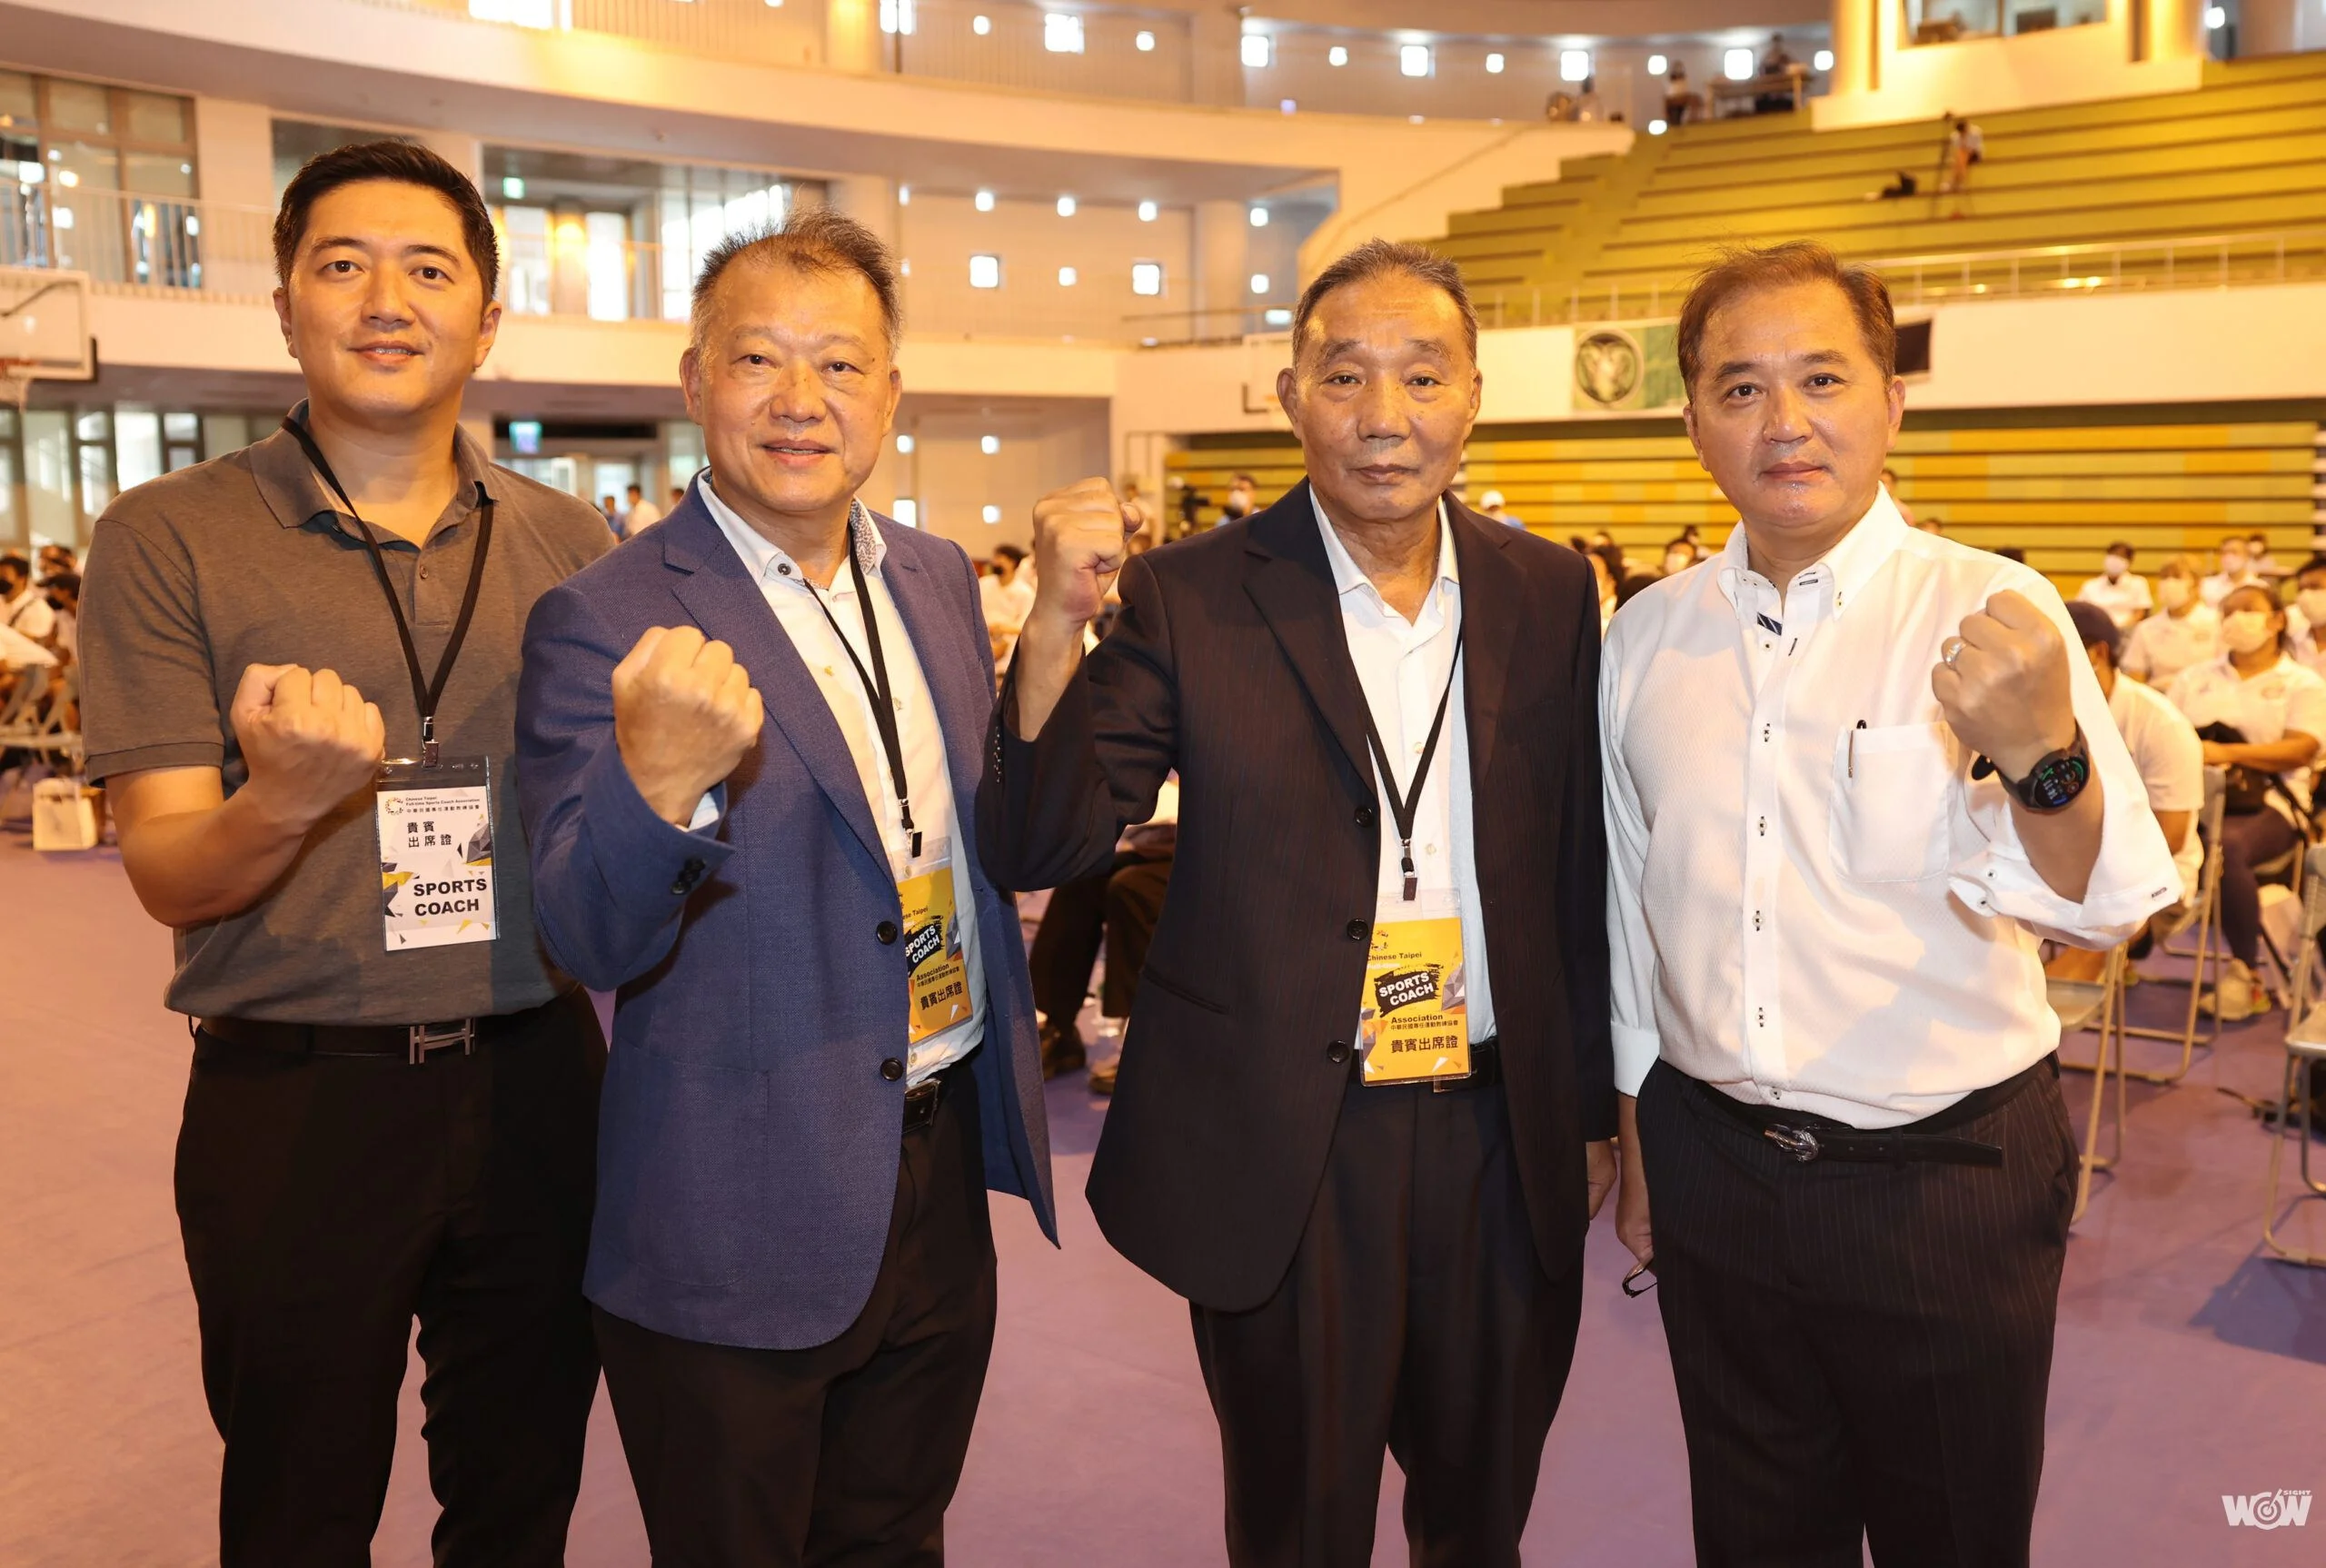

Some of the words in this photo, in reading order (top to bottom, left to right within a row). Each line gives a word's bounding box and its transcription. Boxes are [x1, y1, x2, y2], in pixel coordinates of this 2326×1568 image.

[407, 820, 434, 833] 貴賓
[408, 834, 452, 848] 出席證
[413, 878, 487, 896] SPORTS
[414, 898, 480, 916] COACH
[912, 905, 929, 916] Taipei
[912, 935, 940, 963] COACH
[1399, 951, 1422, 959] Taipei
[916, 963, 949, 982] Association
[1378, 972, 1429, 997] SPORTS
[920, 981, 963, 1010] 貴賓出席證
[1389, 983, 1434, 1006] COACH
[1391, 1014, 1443, 1024] Association
[1391, 1036, 1458, 1053] 貴賓出席證
